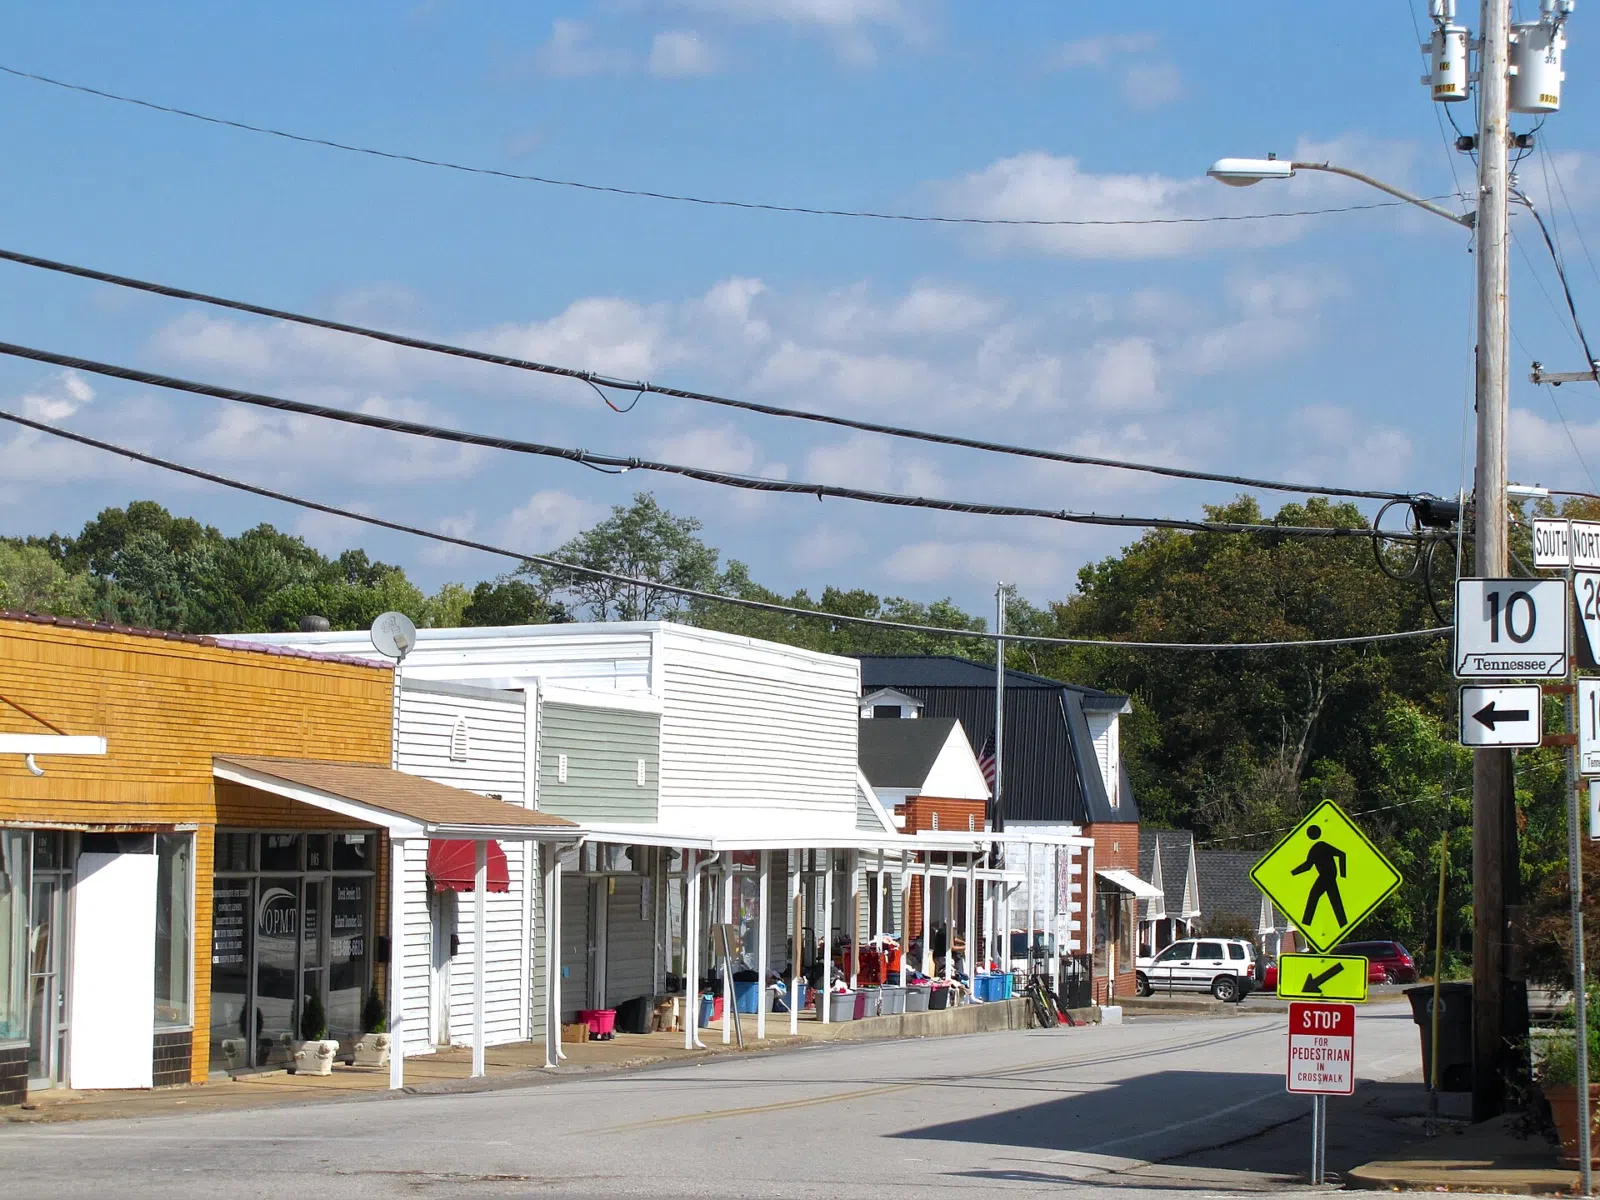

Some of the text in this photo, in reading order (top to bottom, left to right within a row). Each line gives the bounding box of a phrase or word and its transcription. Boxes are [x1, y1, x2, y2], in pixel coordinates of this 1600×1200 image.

[1536, 527, 1568, 557] SOUTH
[1487, 591, 1536, 644] 10
[1474, 658, 1546, 670] Tennessee
[266, 908, 296, 934] OPMT
[1303, 1010, 1341, 1029] STOP
[1314, 1037, 1328, 1046] FOR
[1292, 1047, 1350, 1061] PEDESTRIAN
[1316, 1063, 1324, 1071] IN
[1298, 1072, 1343, 1083] CROSSWALK
